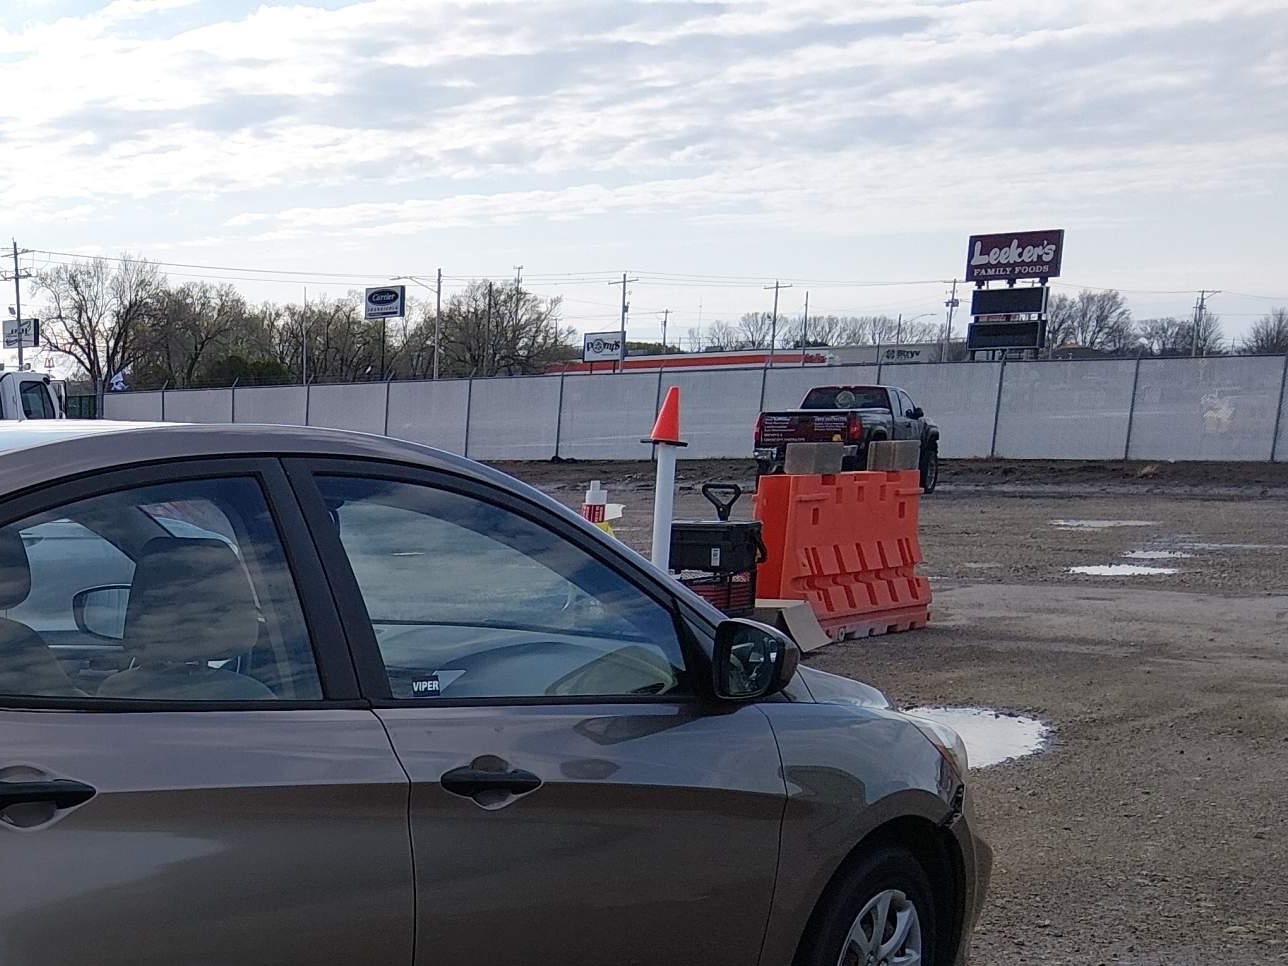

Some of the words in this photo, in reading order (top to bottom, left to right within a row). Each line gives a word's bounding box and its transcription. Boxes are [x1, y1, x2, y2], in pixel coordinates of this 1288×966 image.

[971, 239, 1056, 266] Leeker's
[974, 267, 1012, 276] FAMILY
[1014, 265, 1049, 274] FOODS
[372, 293, 396, 301] Carrier
[412, 680, 439, 692] VIPER
